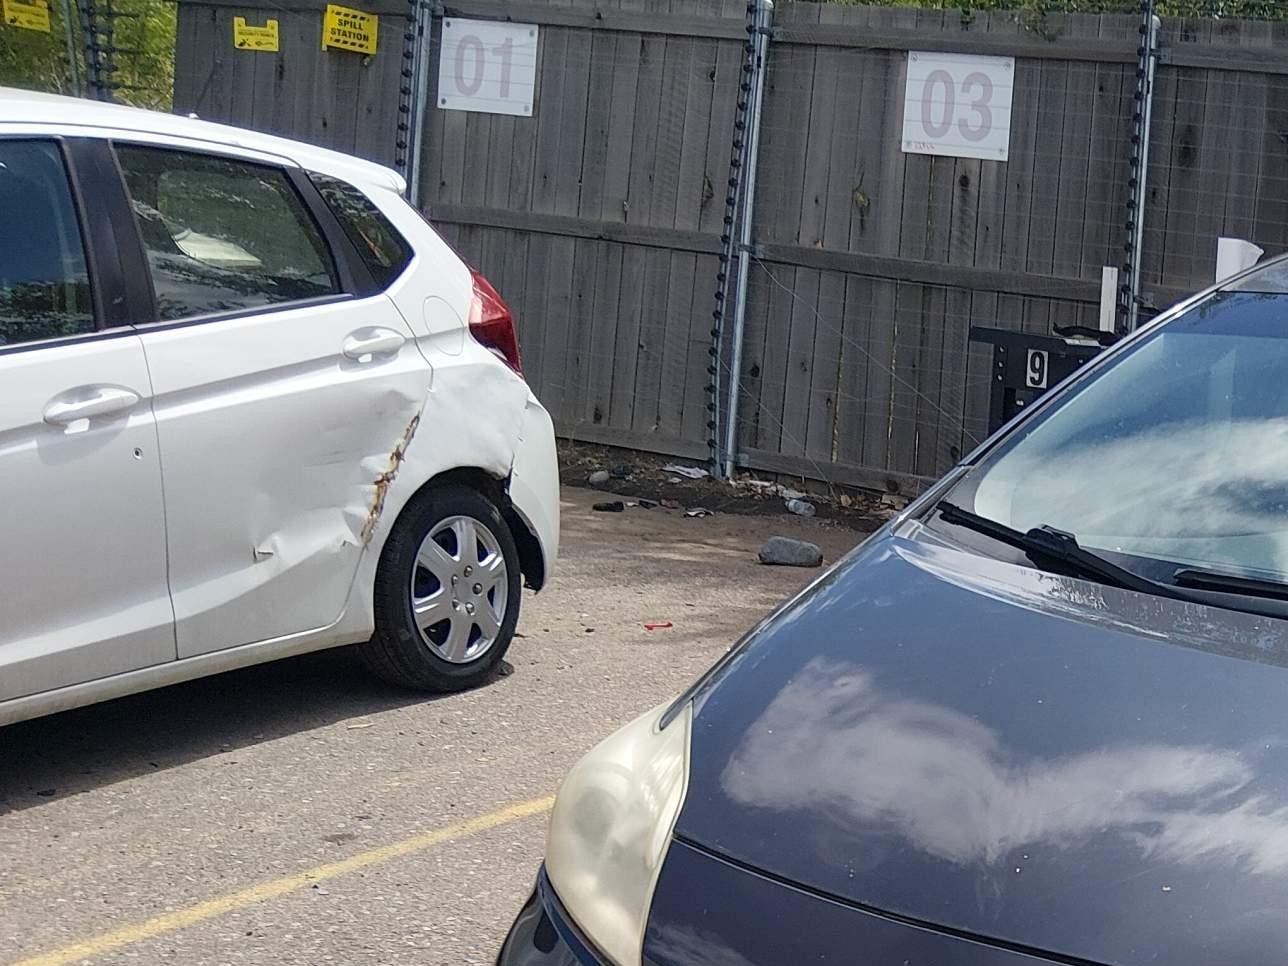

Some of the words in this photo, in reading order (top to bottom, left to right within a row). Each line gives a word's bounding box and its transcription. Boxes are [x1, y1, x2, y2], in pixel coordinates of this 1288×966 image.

[330, 27, 369, 43] STATION
[337, 18, 364, 31] SPILL
[454, 34, 513, 98] 01
[921, 69, 993, 142] 03
[1029, 351, 1045, 386] 9
